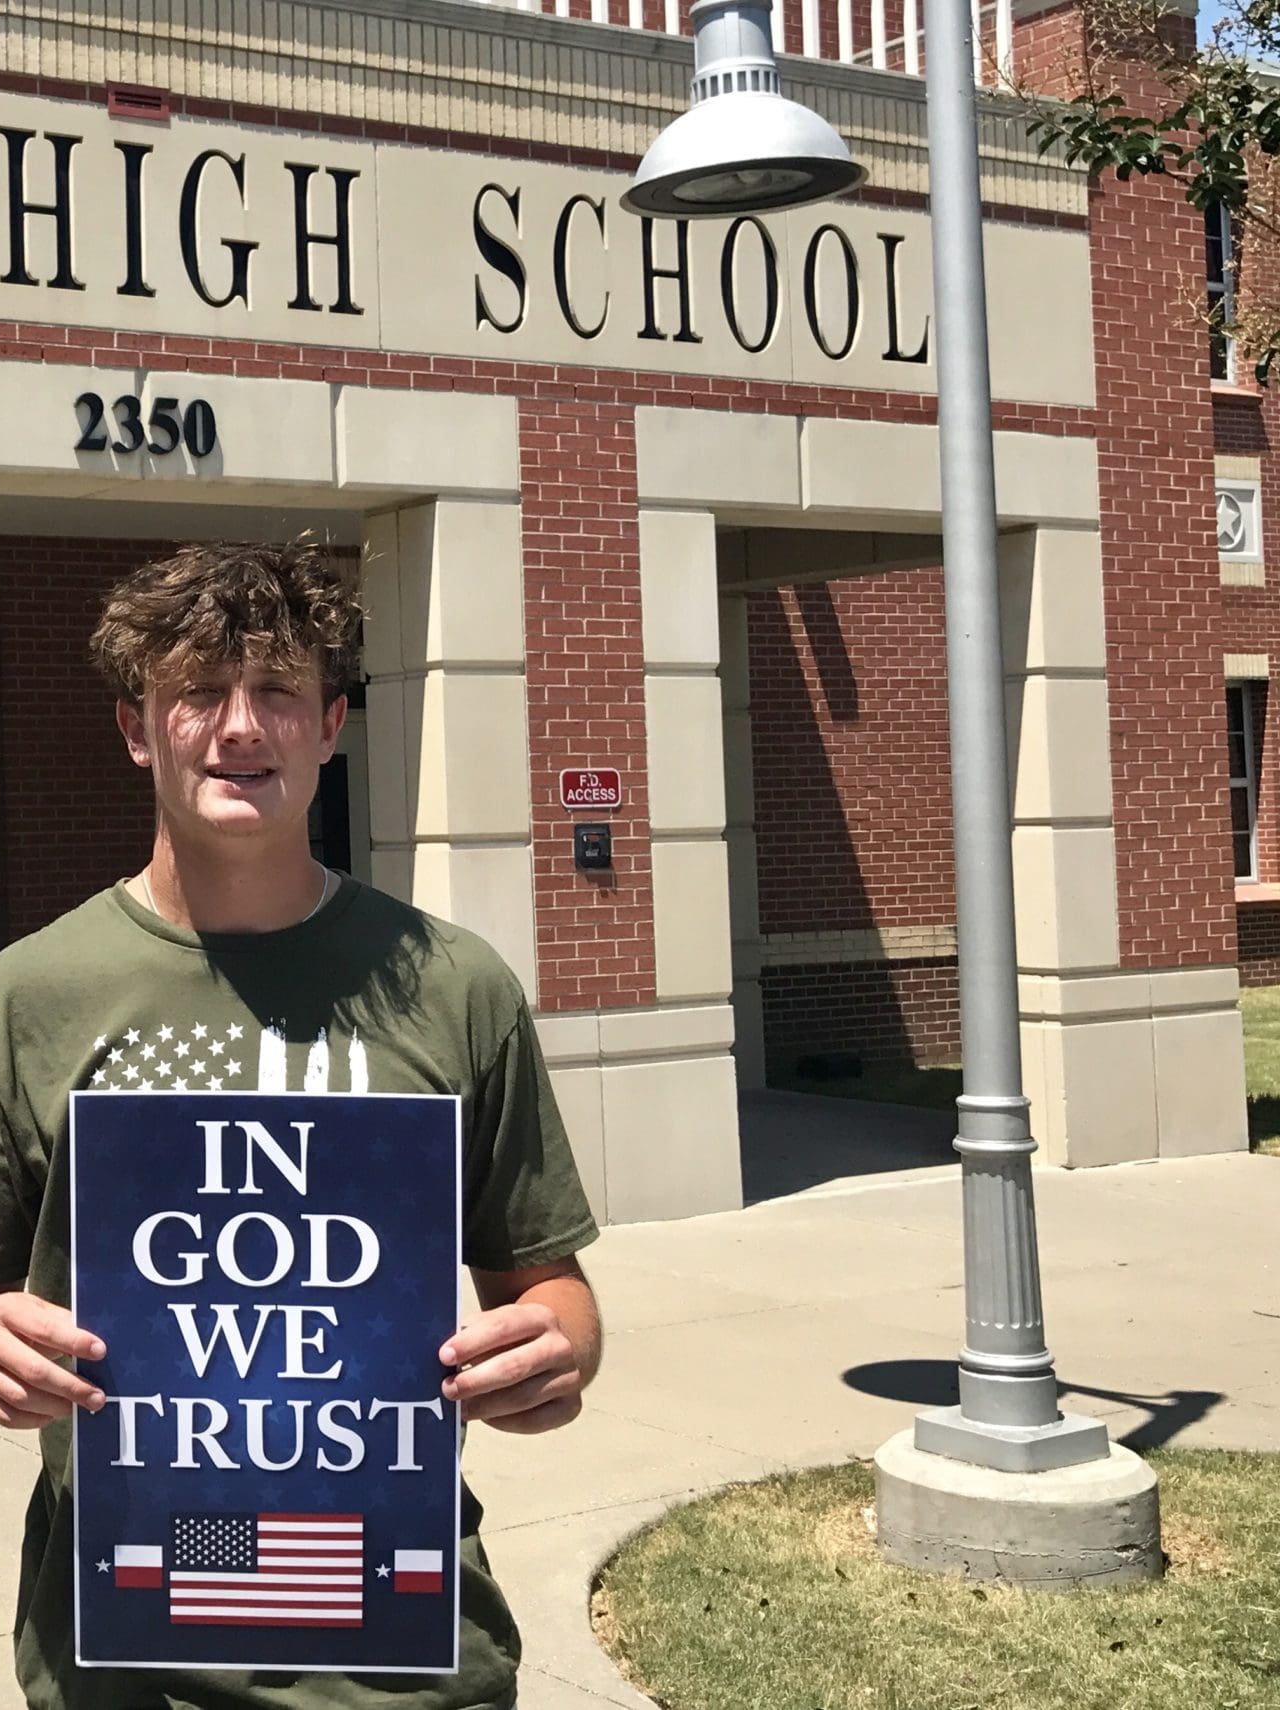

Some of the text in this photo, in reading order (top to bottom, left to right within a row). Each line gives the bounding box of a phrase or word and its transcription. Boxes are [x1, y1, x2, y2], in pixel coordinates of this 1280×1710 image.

[473, 182, 930, 363] SCHOOL
[73, 391, 217, 458] 2350
[566, 787, 616, 802] ACCESS
[579, 773, 602, 787] F.D.
[195, 1120, 315, 1195] IN
[131, 1211, 381, 1288] GOD
[167, 1302, 343, 1380] WE
[91, 1392, 444, 1473] TRUST
